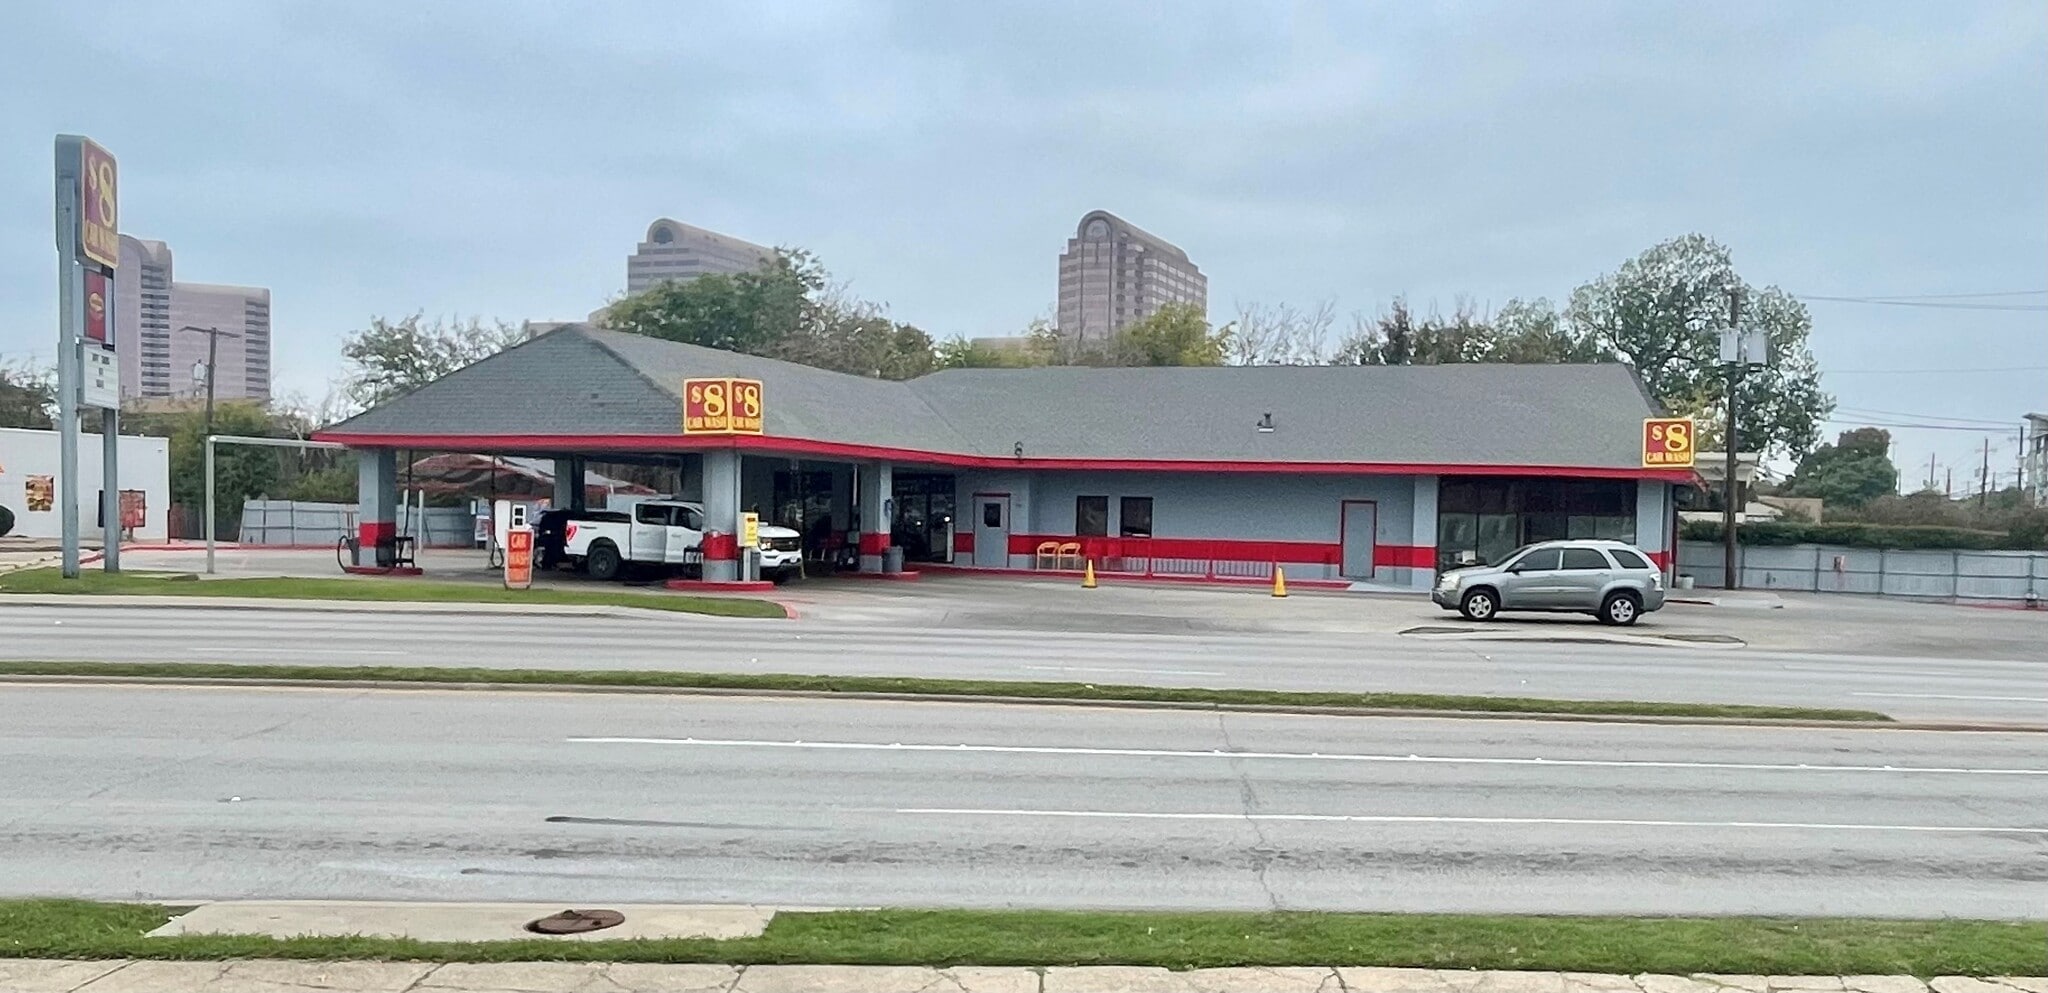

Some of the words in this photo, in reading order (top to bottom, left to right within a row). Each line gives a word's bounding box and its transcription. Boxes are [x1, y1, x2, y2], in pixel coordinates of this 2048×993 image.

[88, 155, 115, 228] $8
[691, 384, 725, 416] $8
[735, 385, 759, 417] $8
[687, 416, 703, 429] CAR
[704, 416, 727, 429] WASH
[1652, 424, 1688, 451] $8
[1647, 452, 1664, 462] CAR
[1665, 452, 1689, 462] WASH
[511, 534, 527, 549] CAR
